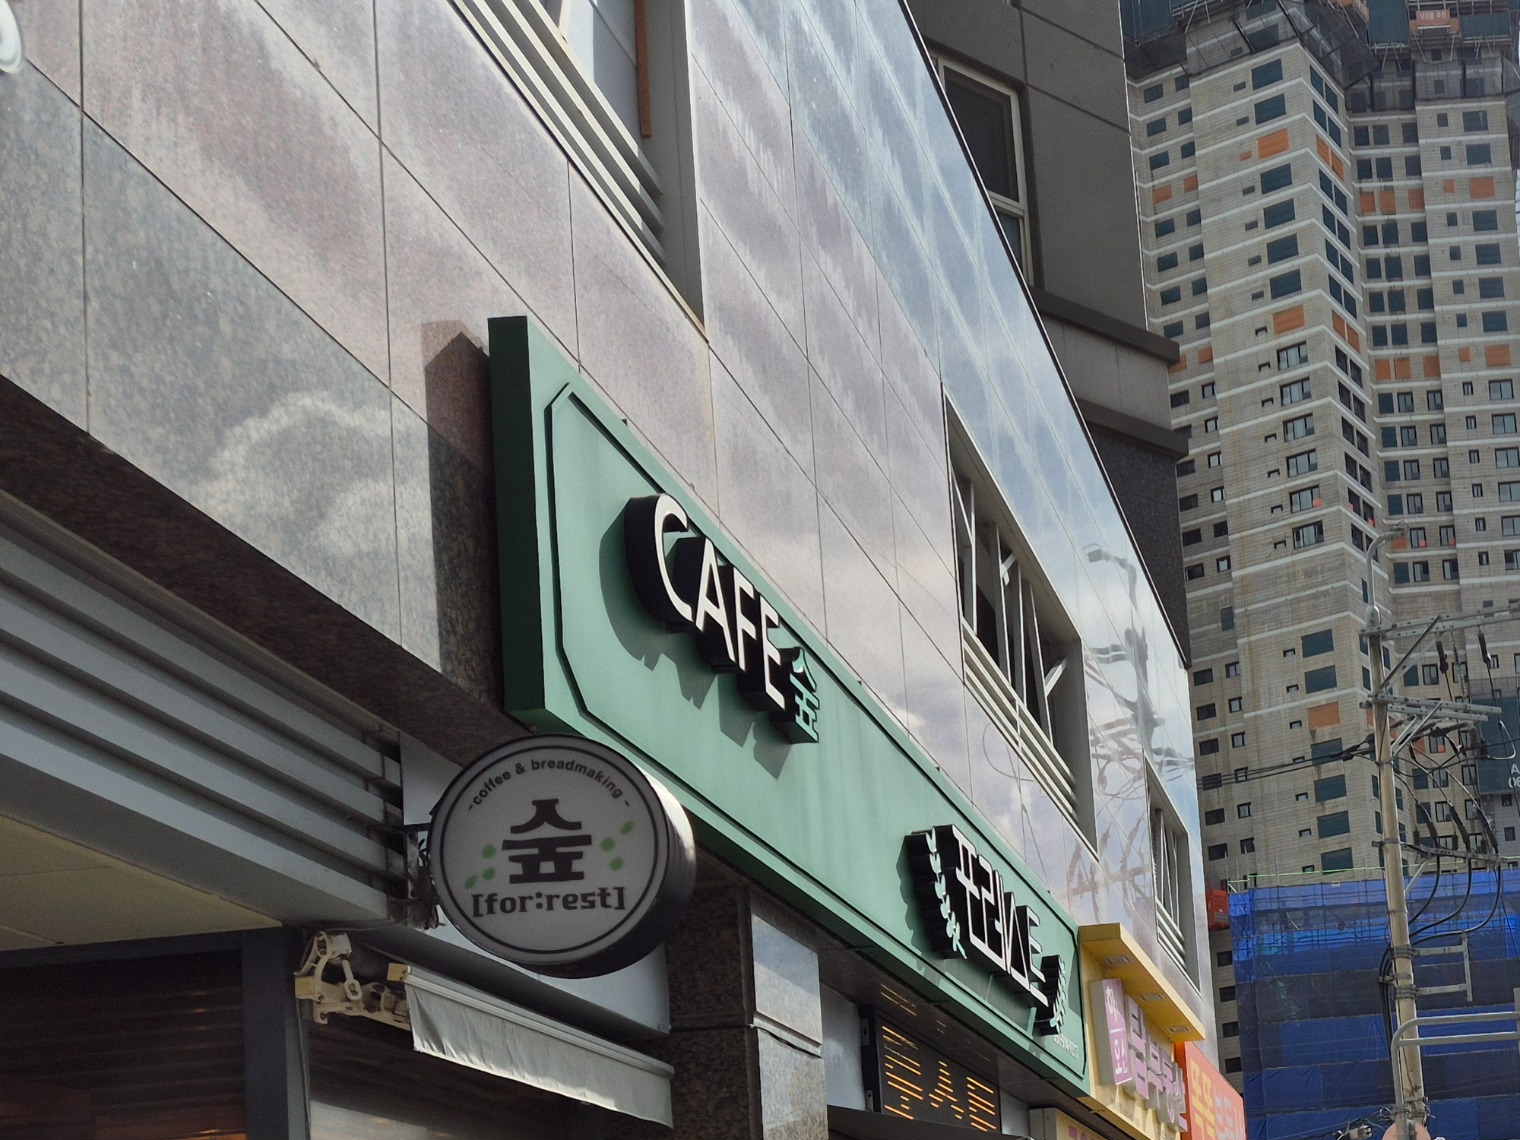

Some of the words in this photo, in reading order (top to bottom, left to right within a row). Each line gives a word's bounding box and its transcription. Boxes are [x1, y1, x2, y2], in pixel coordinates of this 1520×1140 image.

[652, 493, 786, 710] CAFE
[530, 759, 623, 799] breadmaking
[1510, 763, 1520, 775] A
[501, 798, 593, 885] 숲
